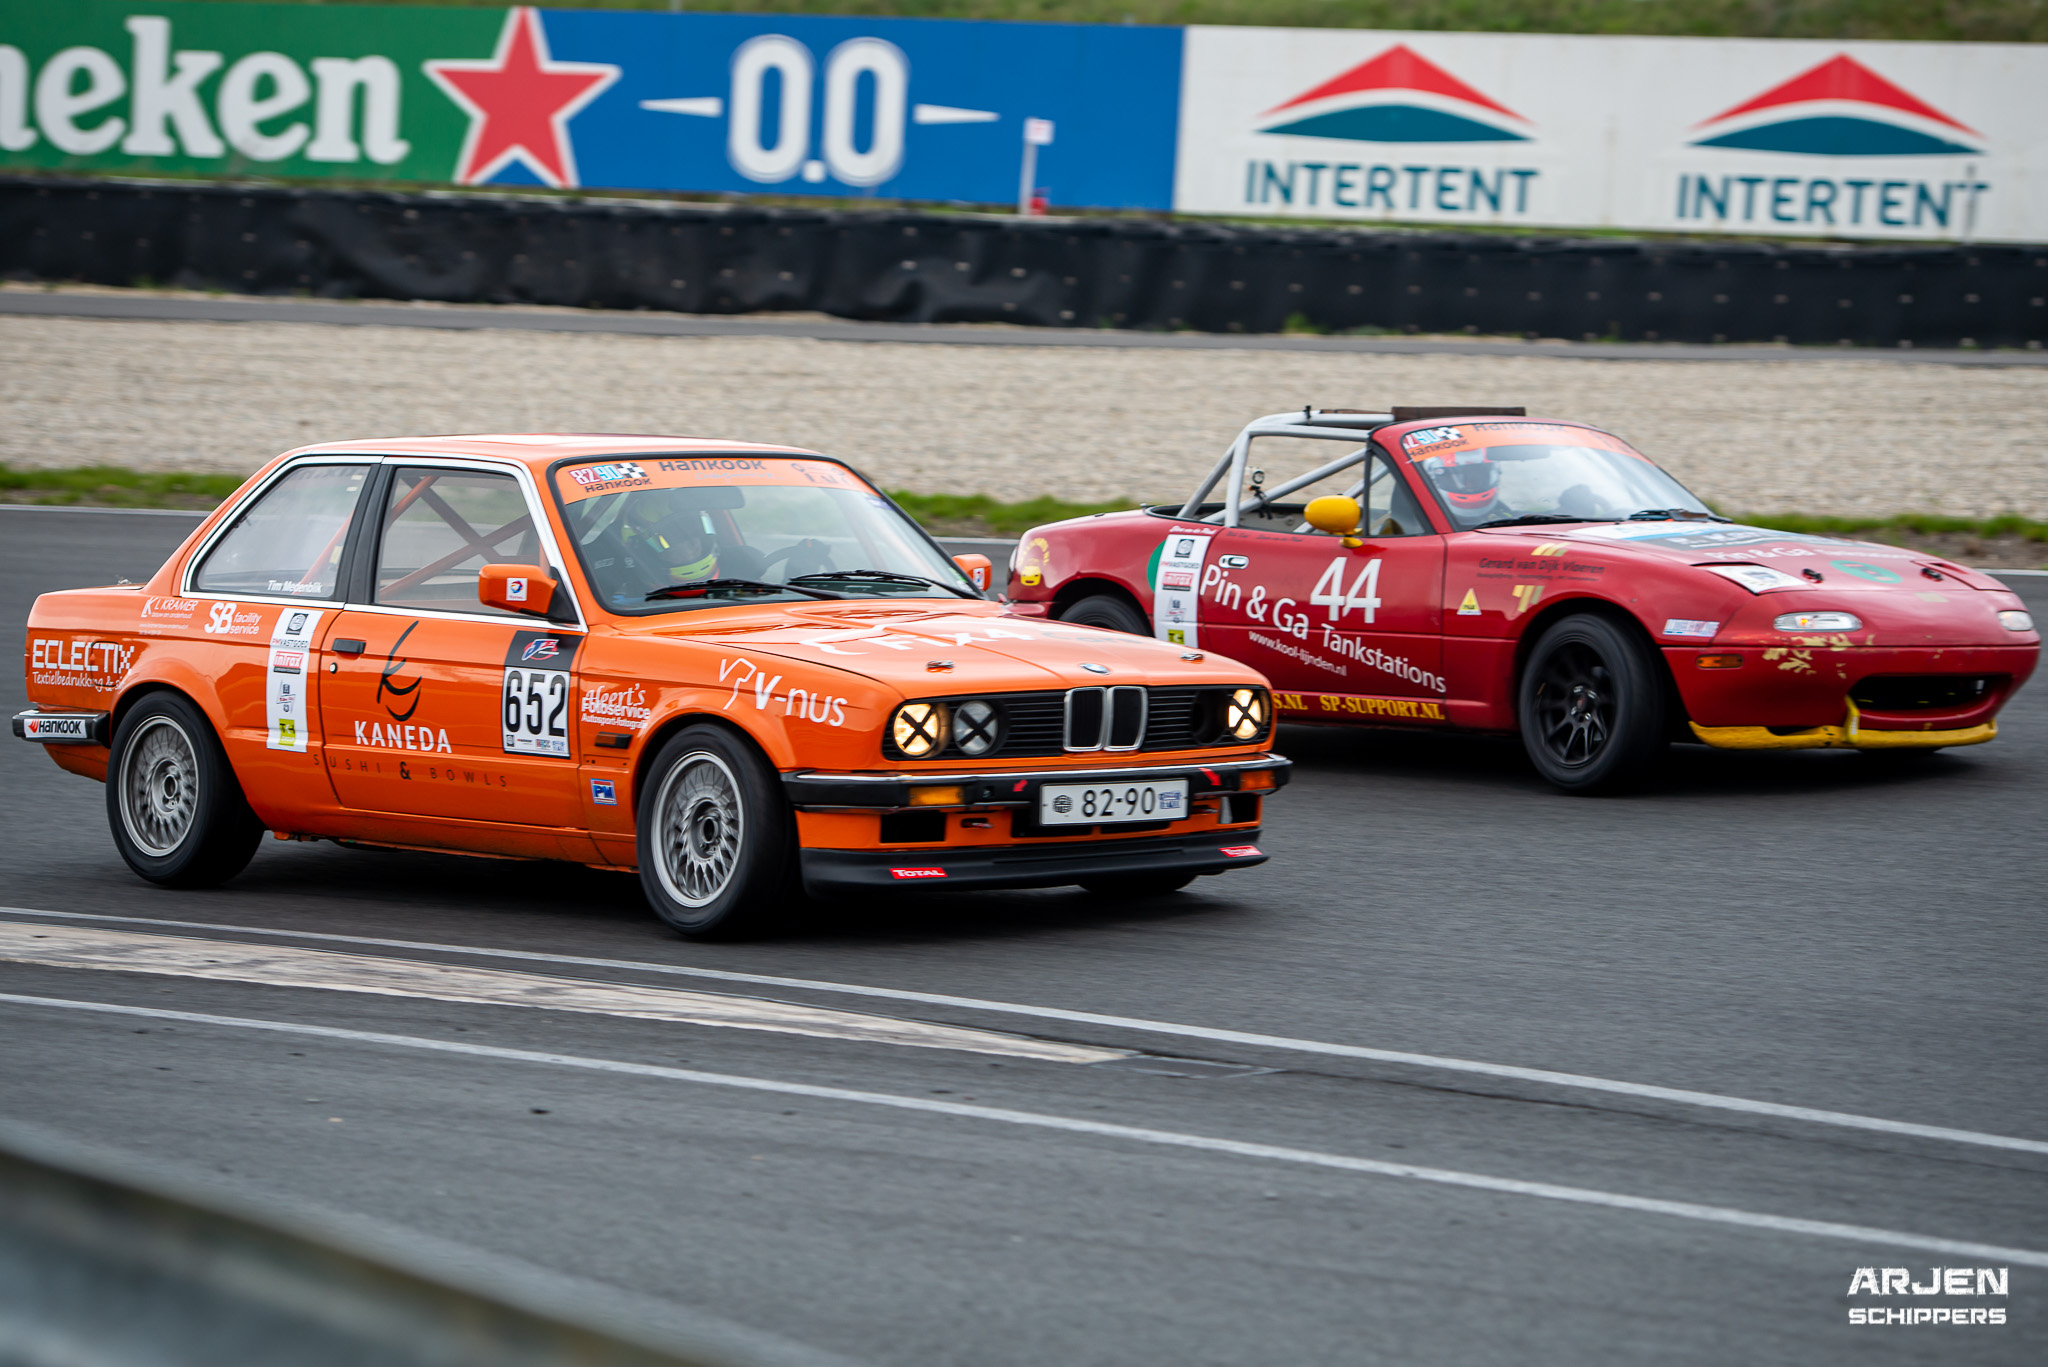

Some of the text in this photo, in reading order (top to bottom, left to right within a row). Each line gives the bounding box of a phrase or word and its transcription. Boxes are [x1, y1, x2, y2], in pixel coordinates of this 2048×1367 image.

[727, 34, 910, 187] 0.0
[1245, 161, 1540, 214] INTERTENT
[1677, 174, 1992, 229] INTERTENT
[267, 579, 283, 592] Tim
[1200, 564, 1309, 640] Pin & Ga
[1310, 556, 1382, 624] 44
[160, 599, 199, 611] KRAMER
[204, 602, 237, 634] SB
[233, 612, 262, 626] facility
[229, 624, 260, 635] service
[32, 639, 135, 675] ECLECTIX
[1321, 623, 1446, 693] Tankstations
[505, 670, 566, 737] 652
[581, 697, 651, 720] Fotoservice
[1320, 695, 1445, 719] SP-SUPPORT.NL
[354, 720, 452, 754] KANEDA
[313, 754, 507, 788] SUSHI & BOWLS
[1082, 787, 1156, 818] 82-90
